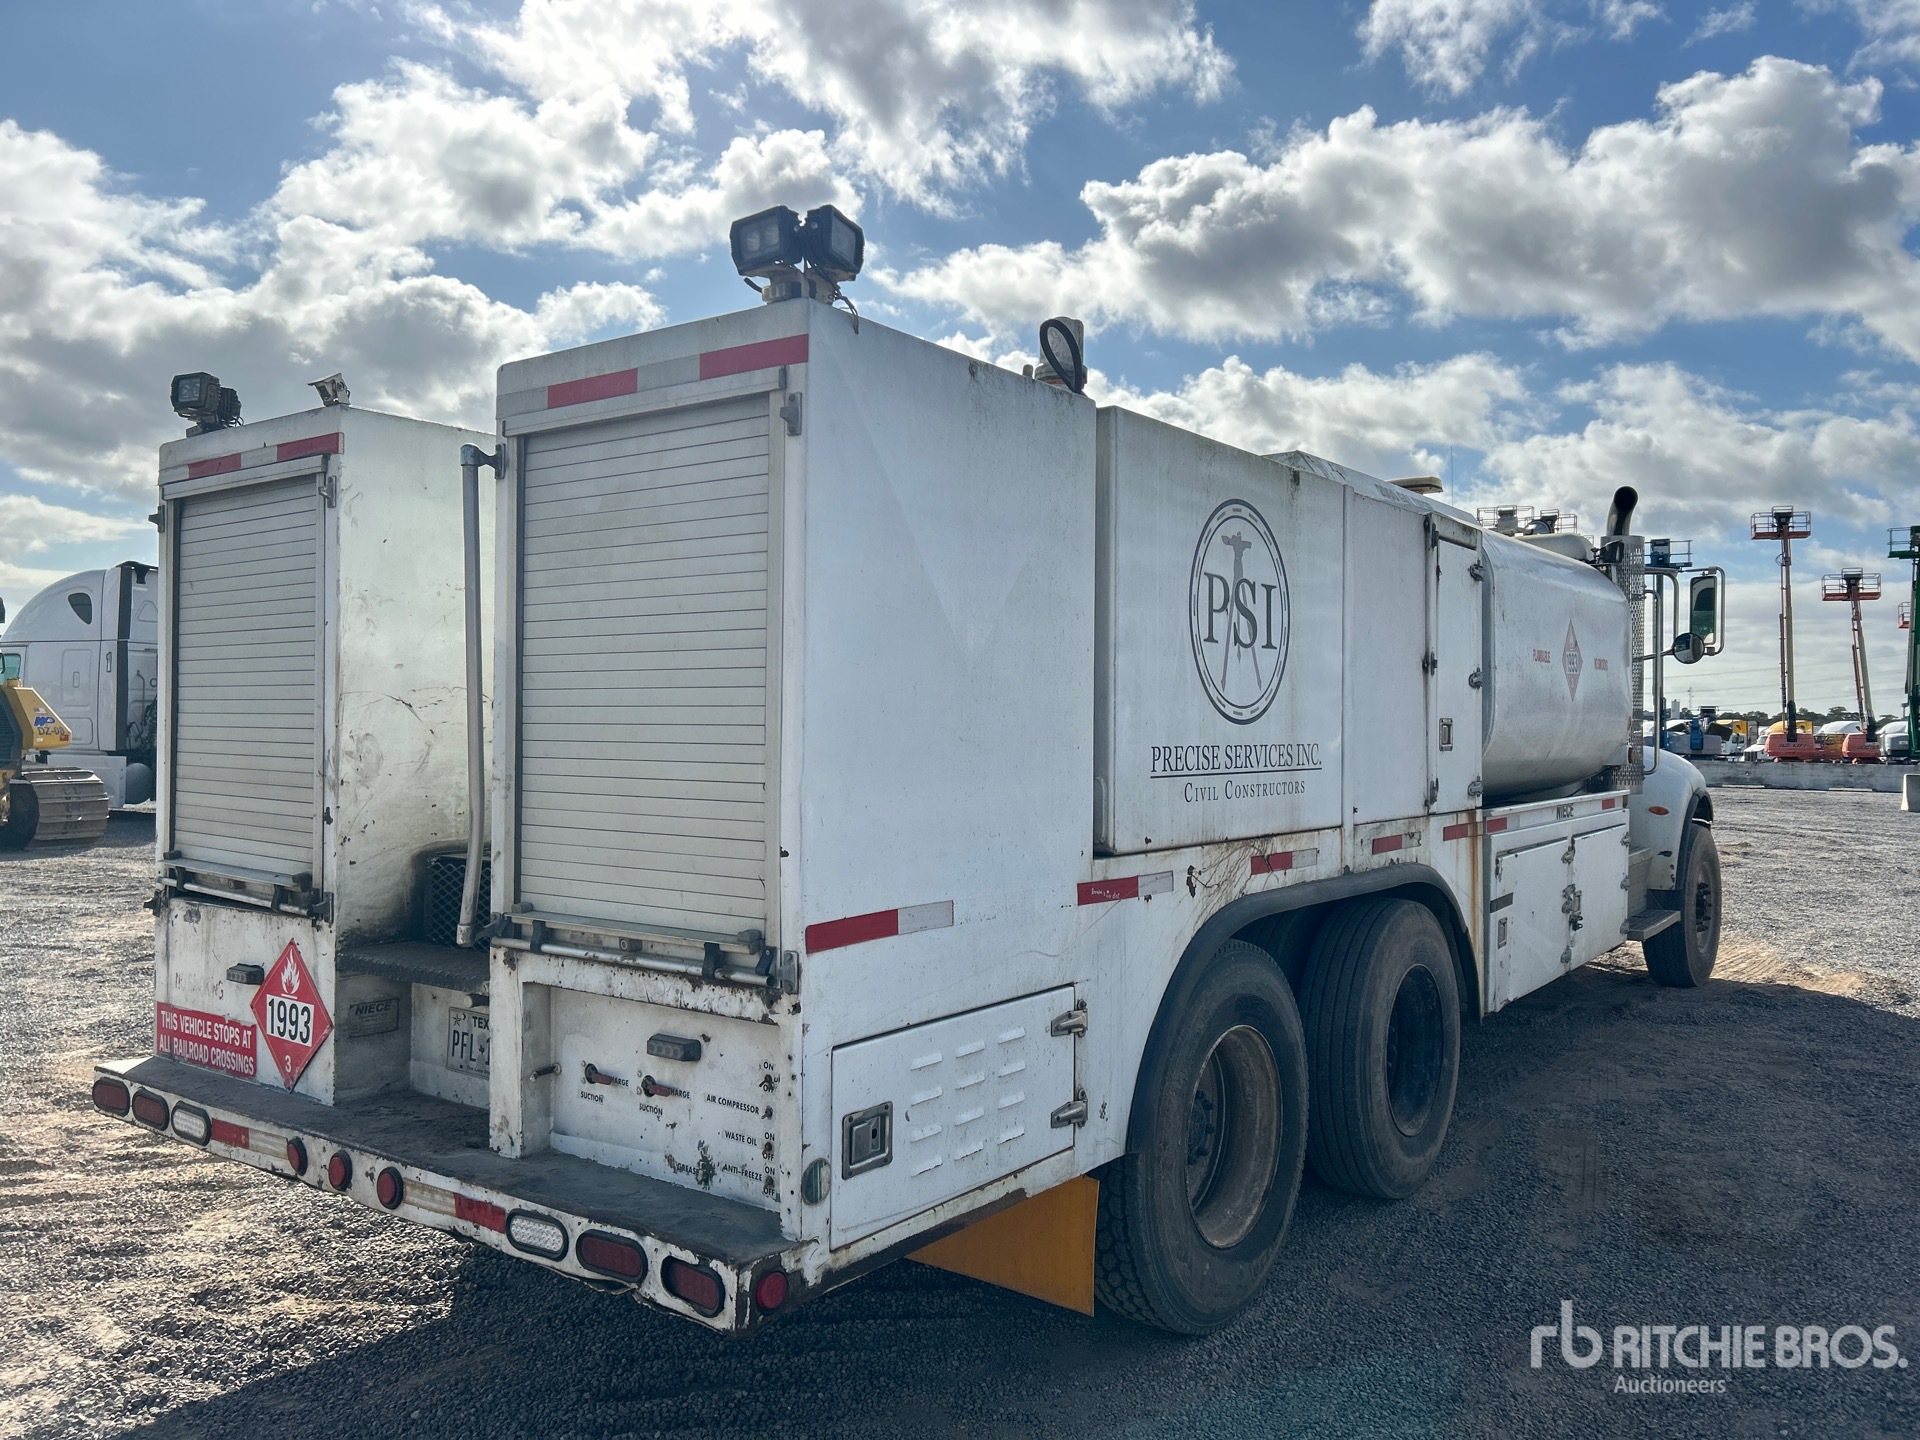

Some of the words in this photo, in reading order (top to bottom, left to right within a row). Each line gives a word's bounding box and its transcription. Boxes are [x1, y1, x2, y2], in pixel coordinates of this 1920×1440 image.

[1203, 571, 1278, 651] PSI
[1150, 745, 1221, 773] PRECISE
[1224, 743, 1293, 771] SERVICES
[1296, 743, 1322, 767] INC.
[1224, 779, 1305, 800] CONSTRUCTORS
[355, 1002, 392, 1016] NIECE
[161, 1010, 178, 1031] THIS
[180, 1015, 212, 1039] VEHICLE
[213, 1022, 240, 1046] STOPS
[242, 1029, 252, 1049] AT
[268, 998, 311, 1044] 1993
[472, 1015, 490, 1031] TEX
[173, 1037, 209, 1063] RAILROAD
[210, 1046, 254, 1076] CROSSINGS
[284, 1054, 292, 1073] 3
[763, 1061, 774, 1071] ON
[580, 1090, 604, 1103] SUCTION
[706, 1094, 717, 1104] AIR
[718, 1097, 760, 1115] COMPRESSOR
[639, 1103, 663, 1116] SUCTION
[724, 1130, 745, 1143] WASTE
[746, 1137, 758, 1147] OIL
[764, 1131, 775, 1141] ON
[762, 1153, 774, 1162] OFF
[722, 1163, 763, 1182] ANTI-FREEZE
[764, 1166, 775, 1176] ON
[763, 1187, 775, 1197] OFF
